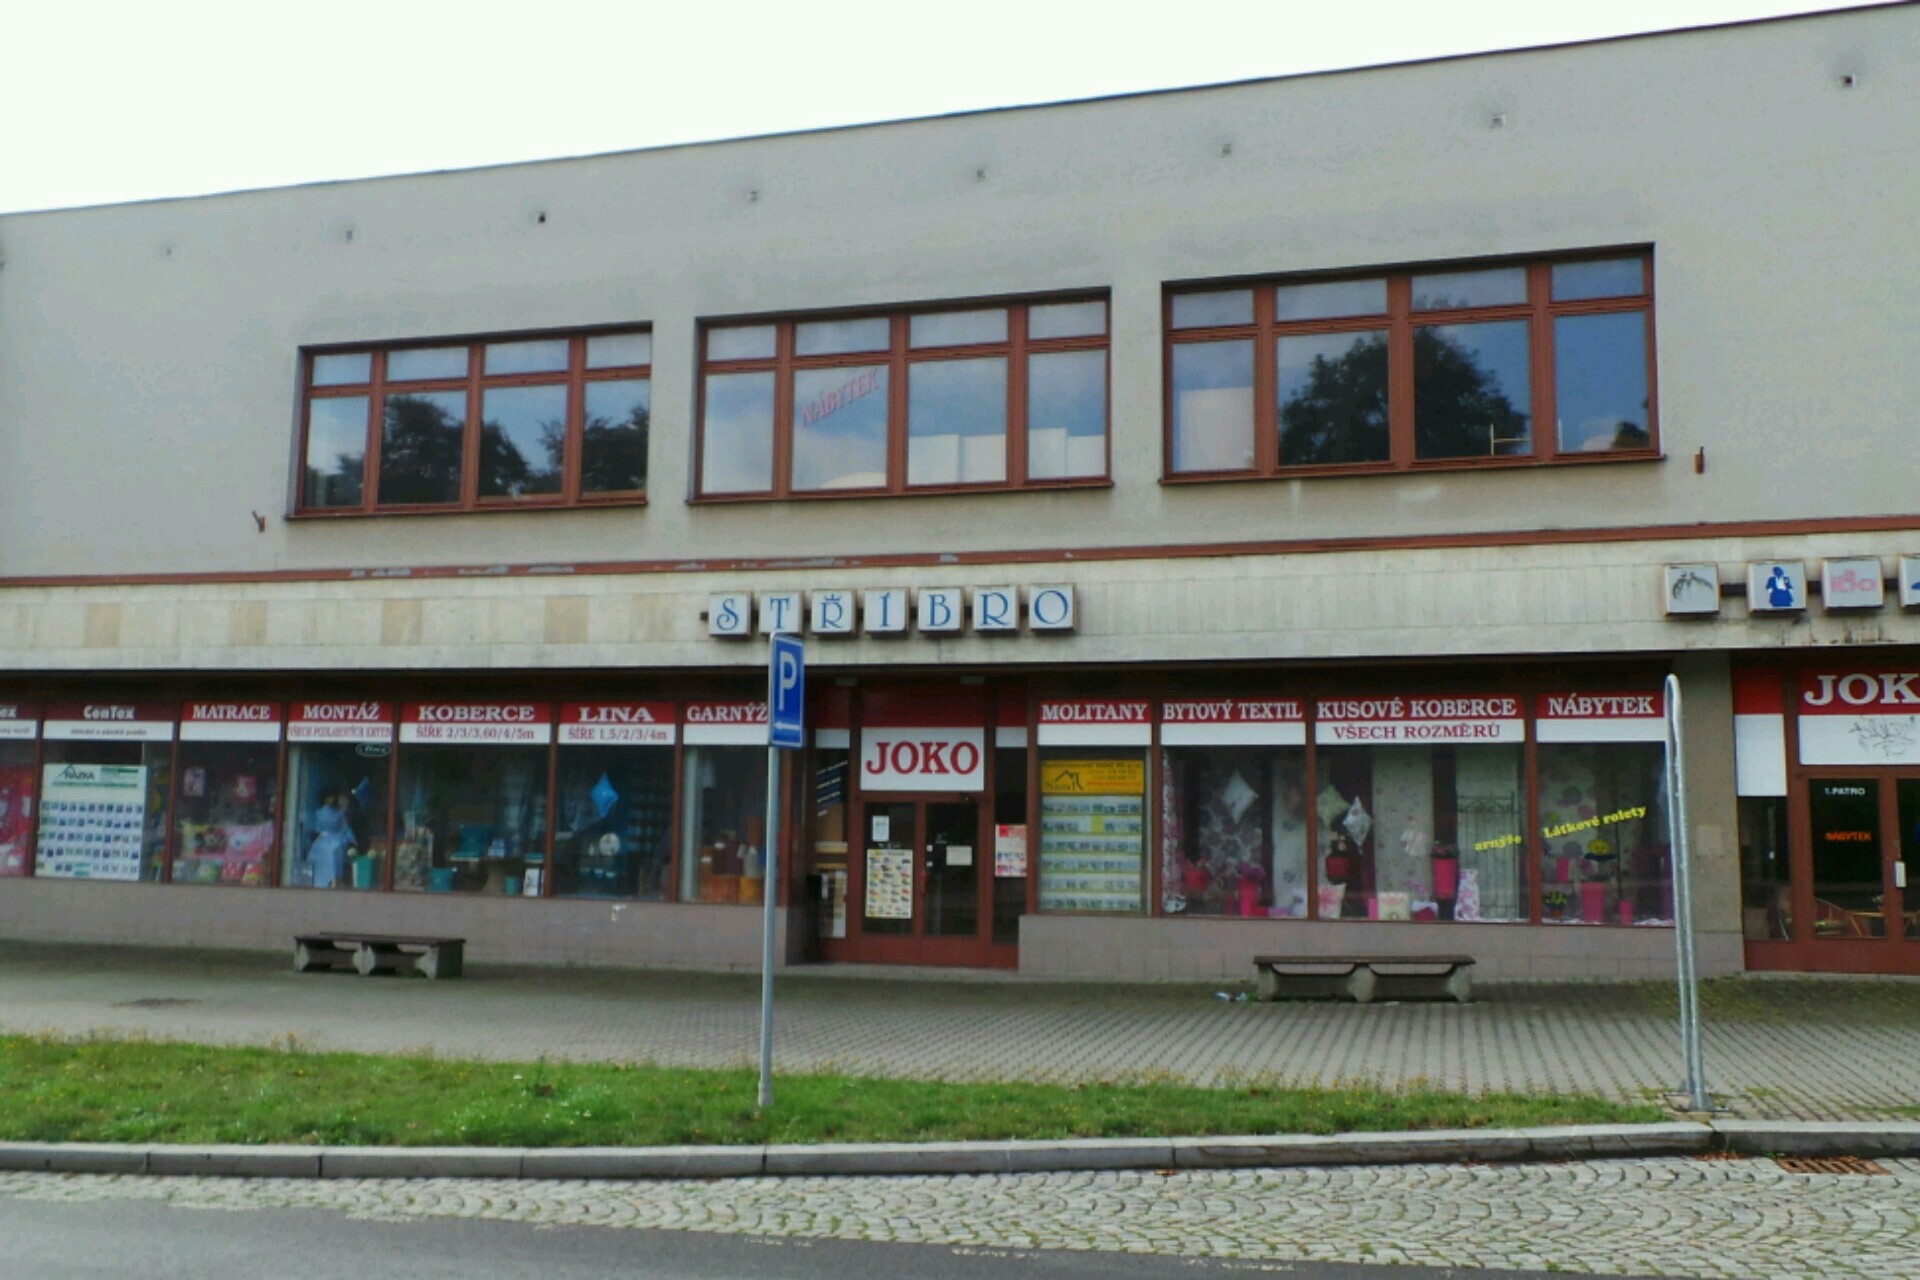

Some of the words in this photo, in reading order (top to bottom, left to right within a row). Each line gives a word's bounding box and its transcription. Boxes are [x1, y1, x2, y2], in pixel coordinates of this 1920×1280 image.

[803, 369, 878, 428] NÁBYTEK
[716, 590, 1069, 630] STŘÍBRO
[778, 651, 797, 711] P
[192, 704, 270, 720] MATRACE
[303, 701, 380, 720] MONTÁŽ
[418, 705, 535, 721] KOBERCE
[579, 706, 655, 722] LINA
[687, 702, 769, 722] GARNÝŽ
[1042, 703, 1148, 721] MOLITANY
[1163, 699, 1233, 720] BYTOVÝ
[1238, 702, 1302, 719] TEXTIL
[1317, 697, 1404, 719] KUSOVÉ
[1410, 699, 1516, 717] KOBERCE
[1548, 693, 1654, 716] NÁBYTEK
[416, 724, 443, 739] ŠÍŘE
[568, 726, 595, 740] ŠÍŘE
[1333, 724, 1396, 739] VŠECH
[865, 741, 980, 774] JOKO
[1543, 815, 1600, 838] Látkové
[1603, 806, 1646, 824] rolety
